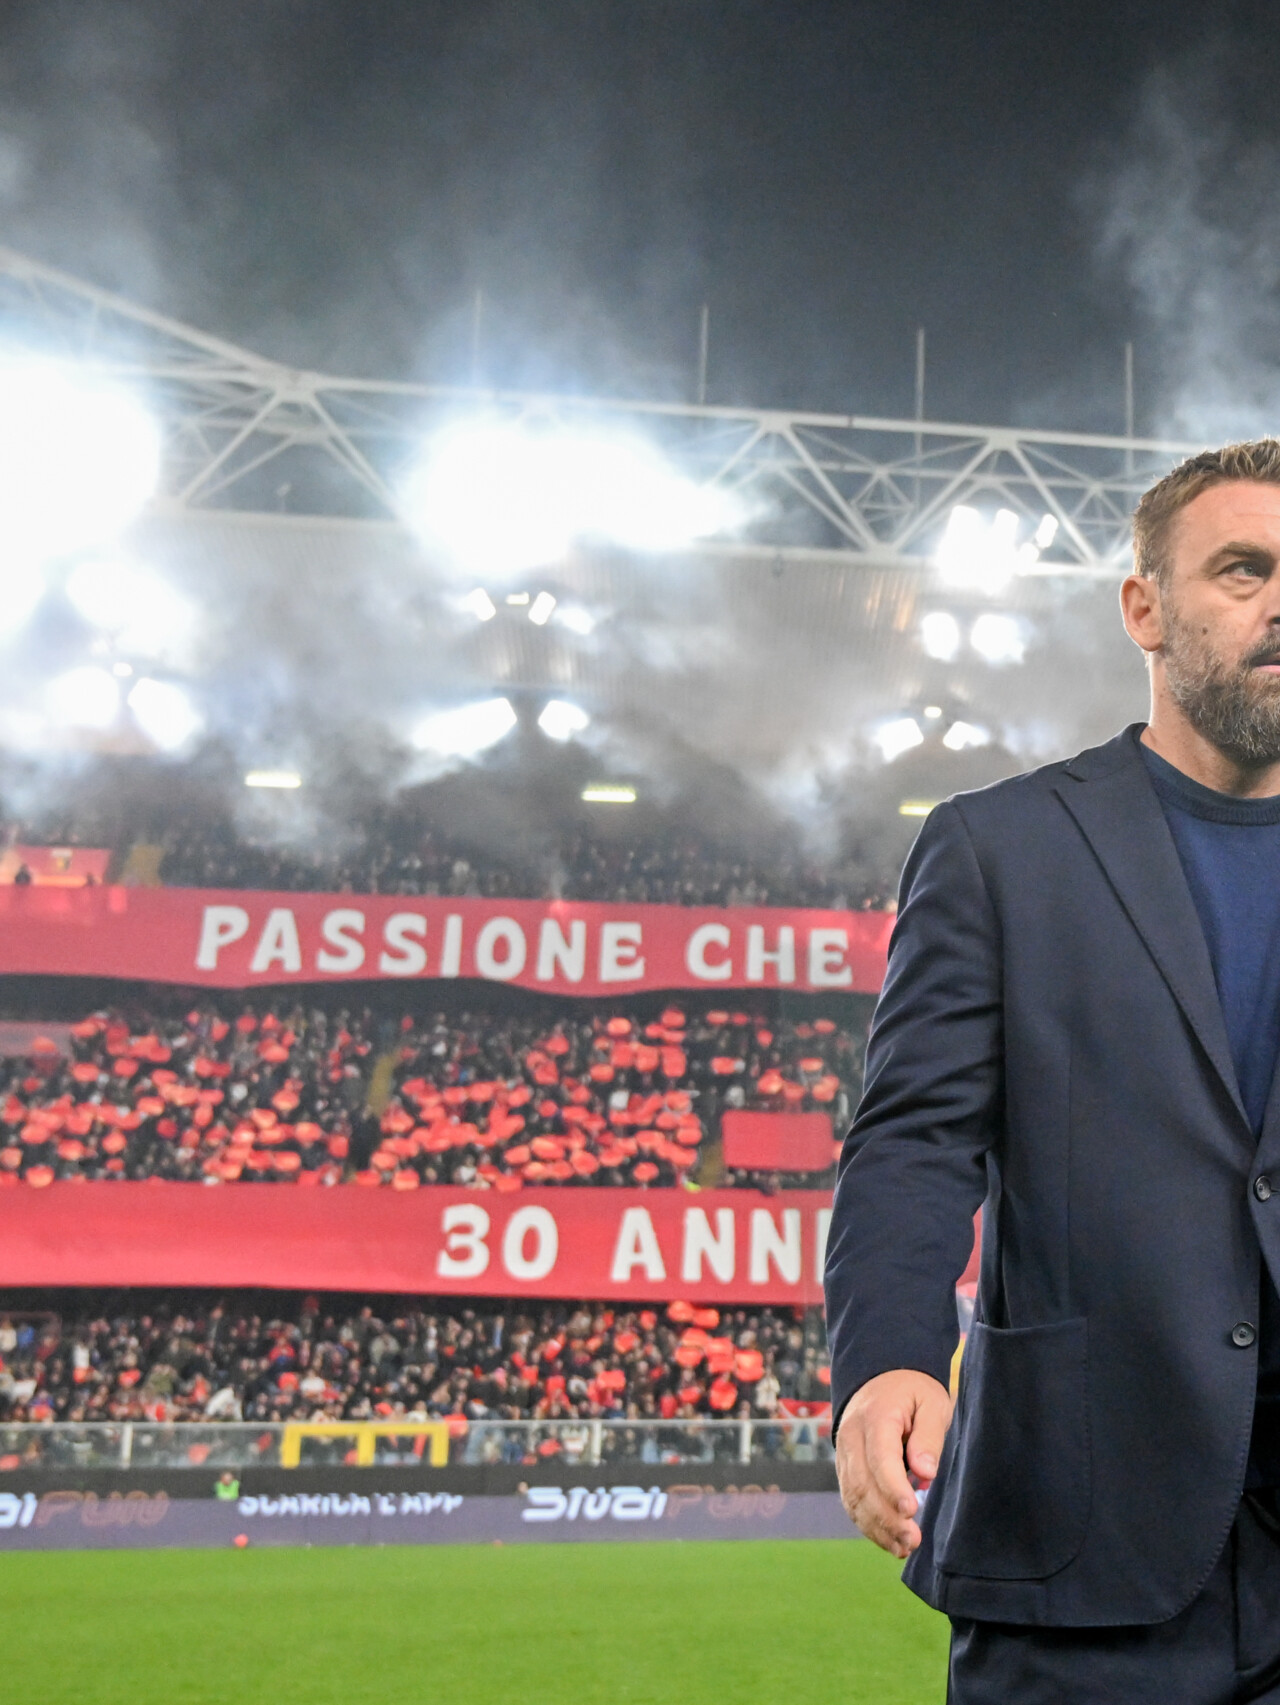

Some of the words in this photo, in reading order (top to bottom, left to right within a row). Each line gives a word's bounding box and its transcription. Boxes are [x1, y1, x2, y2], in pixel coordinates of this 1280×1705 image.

[196, 907, 645, 982] PASSIONE
[687, 924, 853, 987] CHE
[437, 1205, 559, 1280] 30
